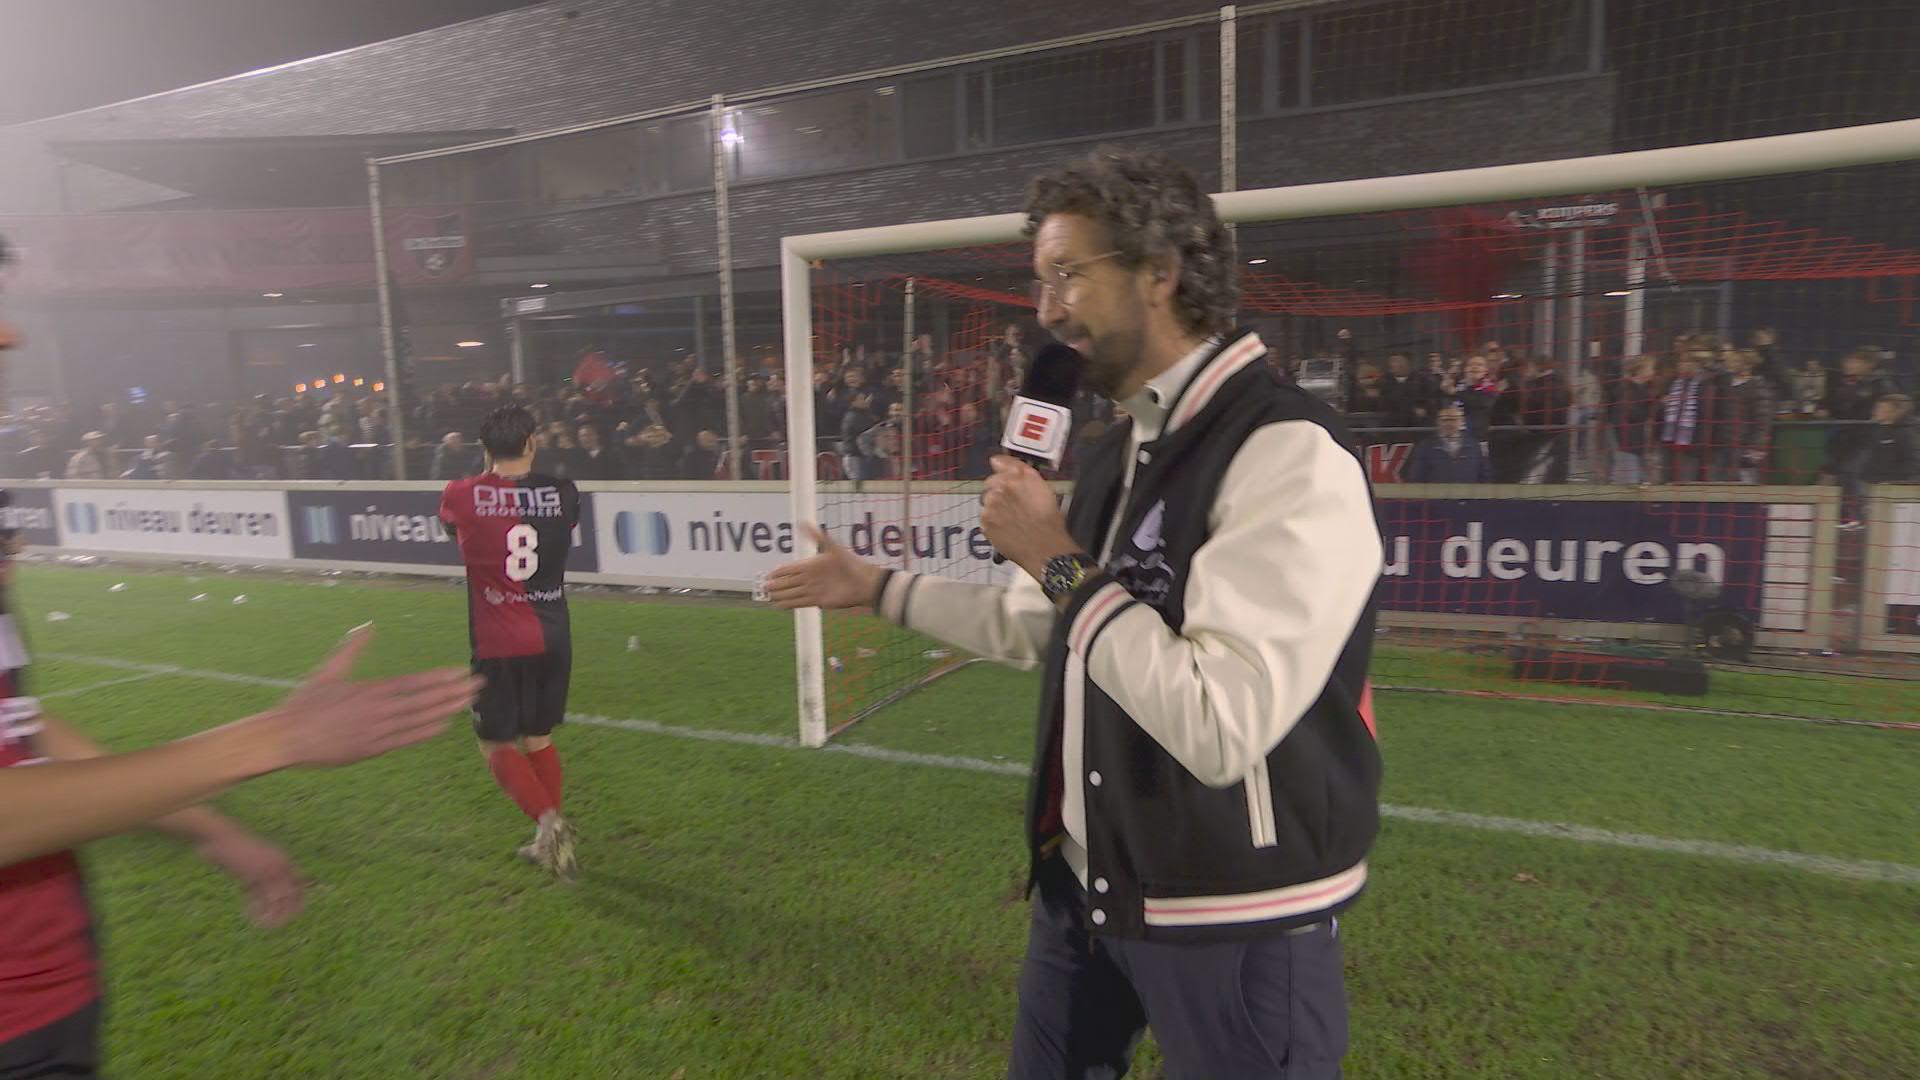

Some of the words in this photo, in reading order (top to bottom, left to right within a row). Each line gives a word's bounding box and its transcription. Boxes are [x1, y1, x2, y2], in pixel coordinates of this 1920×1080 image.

[105, 501, 182, 533] niveau
[188, 502, 279, 536] deuren
[851, 512, 993, 560] deure
[505, 523, 539, 582] 8
[1440, 522, 1725, 585] deuren
